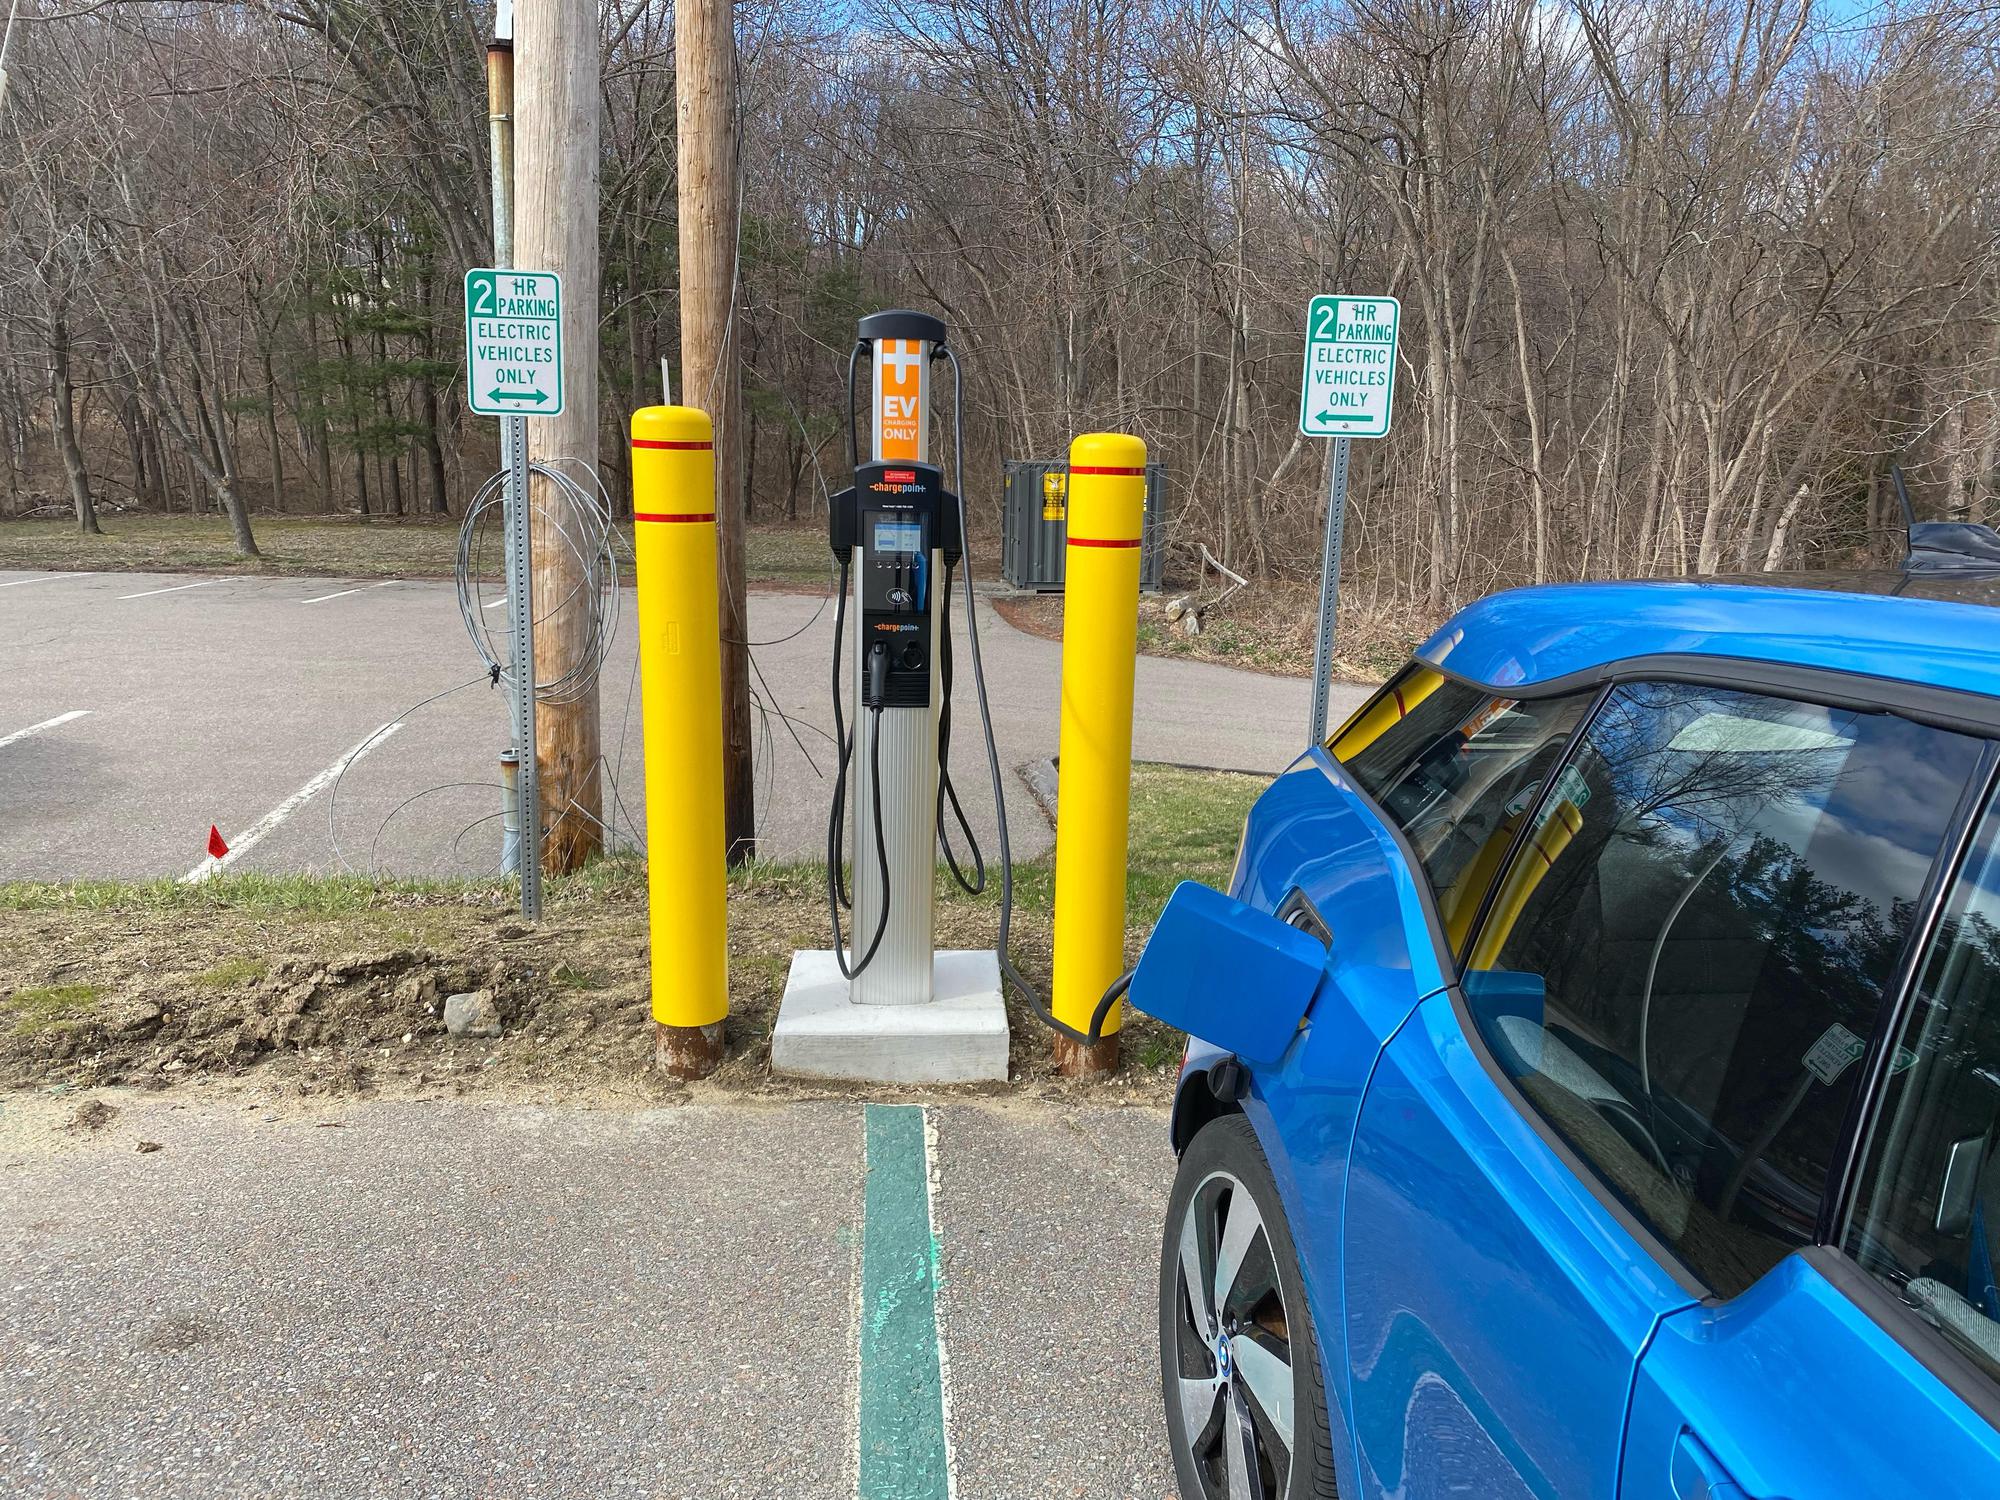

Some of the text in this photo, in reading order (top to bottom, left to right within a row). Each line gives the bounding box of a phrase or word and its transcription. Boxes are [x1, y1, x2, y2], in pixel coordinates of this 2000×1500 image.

[473, 278, 537, 314] 2 HR
[499, 298, 555, 317] PARKING
[1314, 304, 1377, 339] 2 HR
[479, 323, 551, 340] ELECTRIC
[1338, 323, 1392, 341] PARKING
[478, 345, 552, 363] VEHICLES
[1318, 348, 1387, 364] ELECTRIC
[496, 368, 536, 384] ONLY
[1315, 370, 1386, 386] VEHICLES
[884, 396, 917, 418] EV
[1329, 391, 1368, 407] ONLY
[884, 428, 917, 440] ONLY
